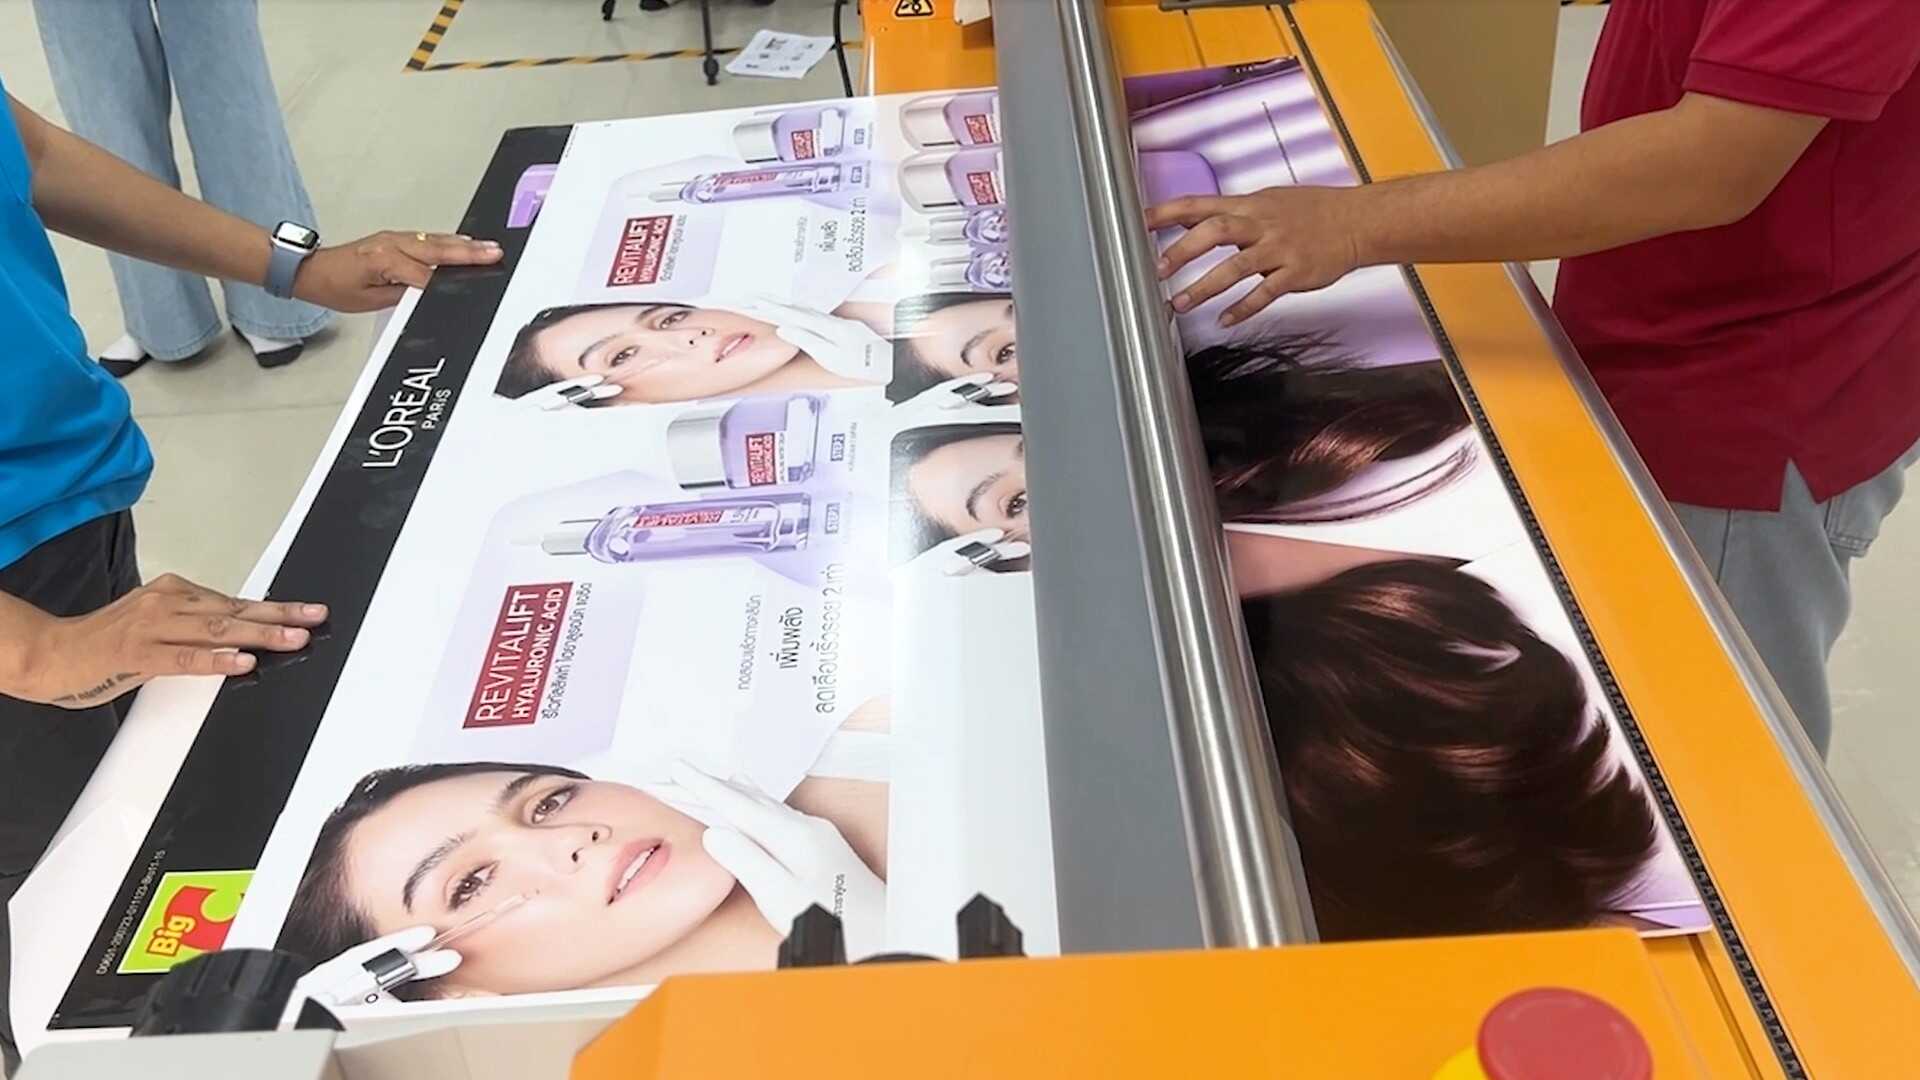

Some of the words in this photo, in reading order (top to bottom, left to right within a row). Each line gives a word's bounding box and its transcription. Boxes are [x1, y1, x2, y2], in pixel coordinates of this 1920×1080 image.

[850, 206, 866, 216] 2
[613, 220, 651, 284] REVITALIFT
[421, 389, 451, 429] PARIS
[822, 586, 842, 597] 2
[474, 590, 540, 721] REVITALIFT
[511, 623, 555, 719] HYALURONIC
[541, 588, 565, 621] ACID
[770, 606, 804, 669] เพิ่มพลัง
[146, 914, 197, 957] Big
